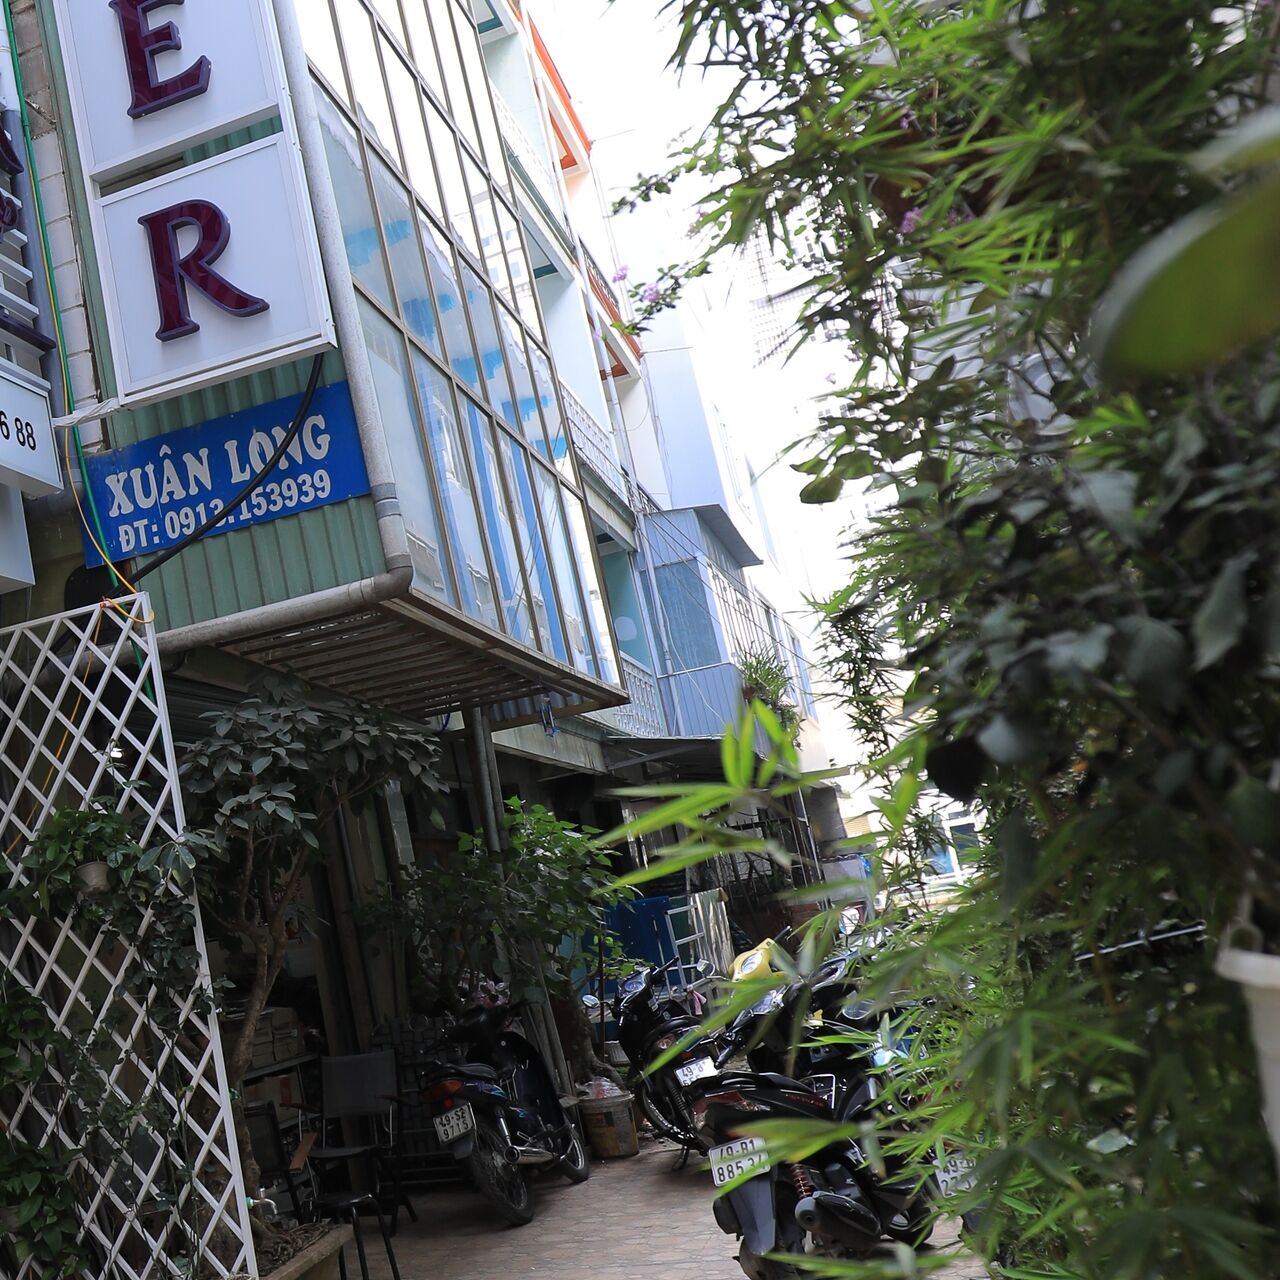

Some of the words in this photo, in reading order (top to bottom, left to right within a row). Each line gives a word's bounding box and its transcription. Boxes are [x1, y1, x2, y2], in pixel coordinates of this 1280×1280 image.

[14, 417, 38, 452] 88
[105, 444, 213, 518] XUÂN
[224, 414, 332, 484] LONG
[118, 517, 161, 553] ĐT:
